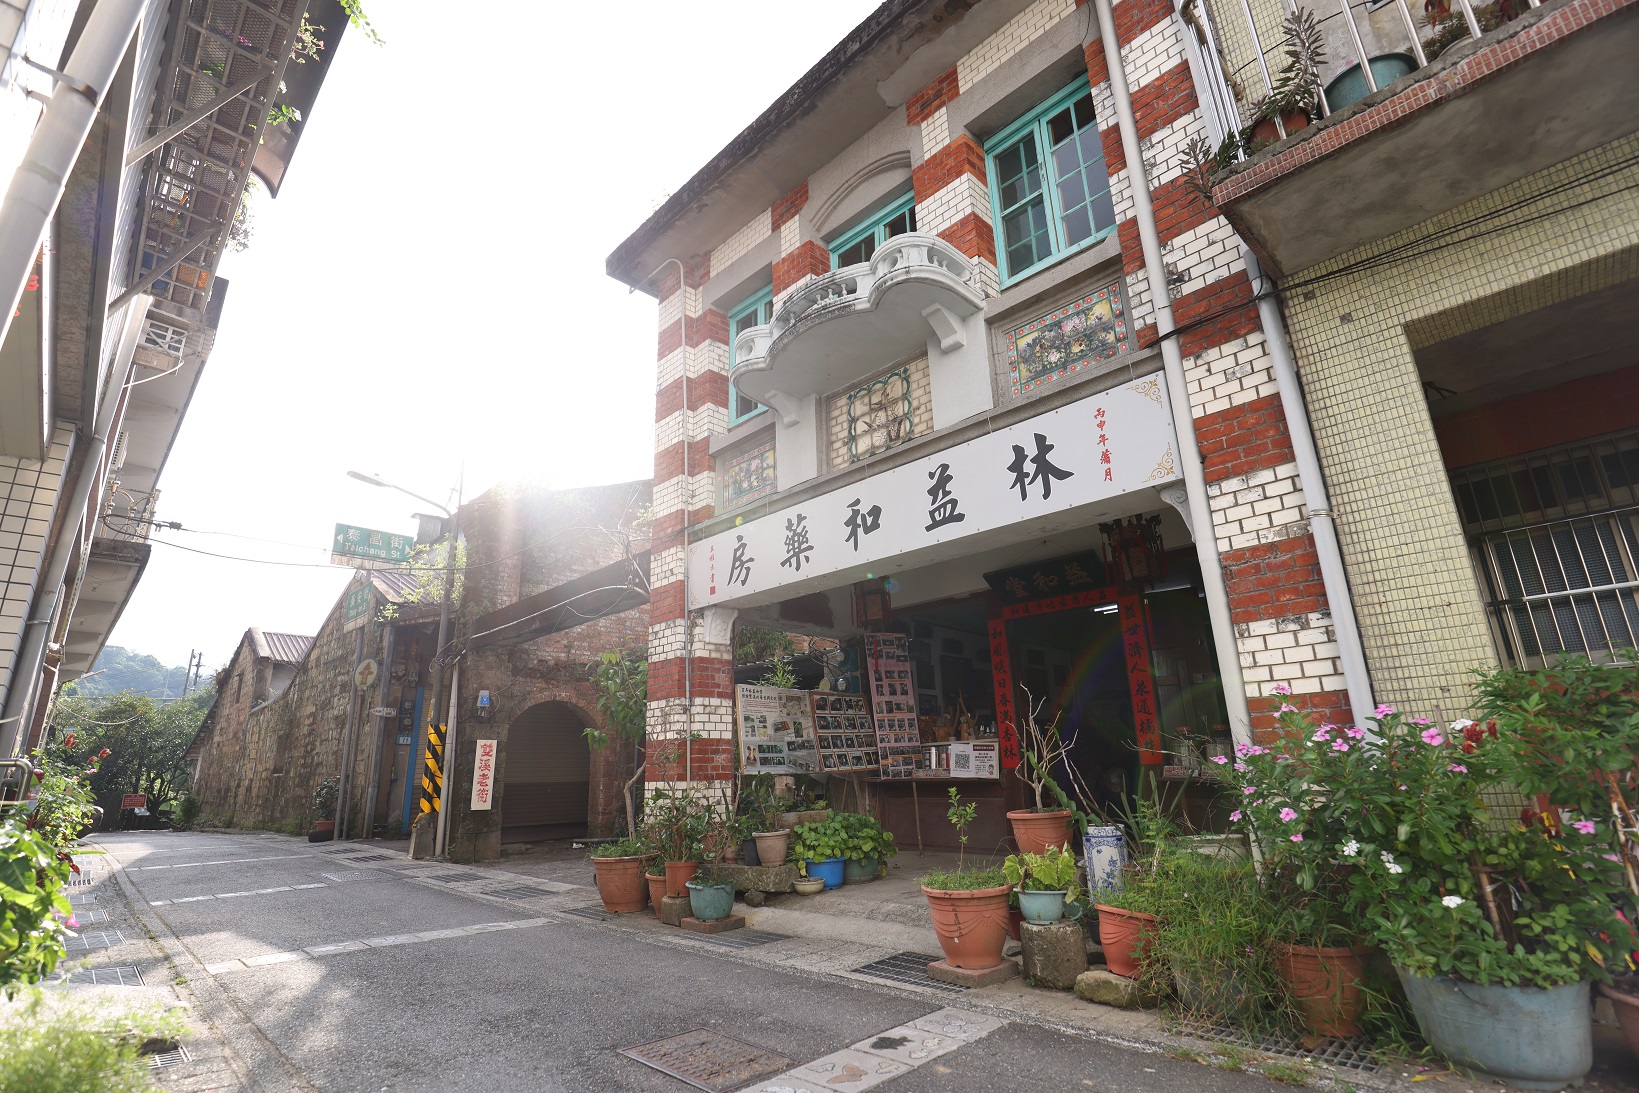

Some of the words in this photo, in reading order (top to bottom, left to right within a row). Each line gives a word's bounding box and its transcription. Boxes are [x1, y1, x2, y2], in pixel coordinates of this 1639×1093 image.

[727, 432, 1075, 587] 林益和藥房
[344, 542, 387, 558] Taichang
[391, 550, 403, 559] St.
[346, 528, 404, 549] 泰昌街
[476, 742, 493, 803] 雙溪老街
